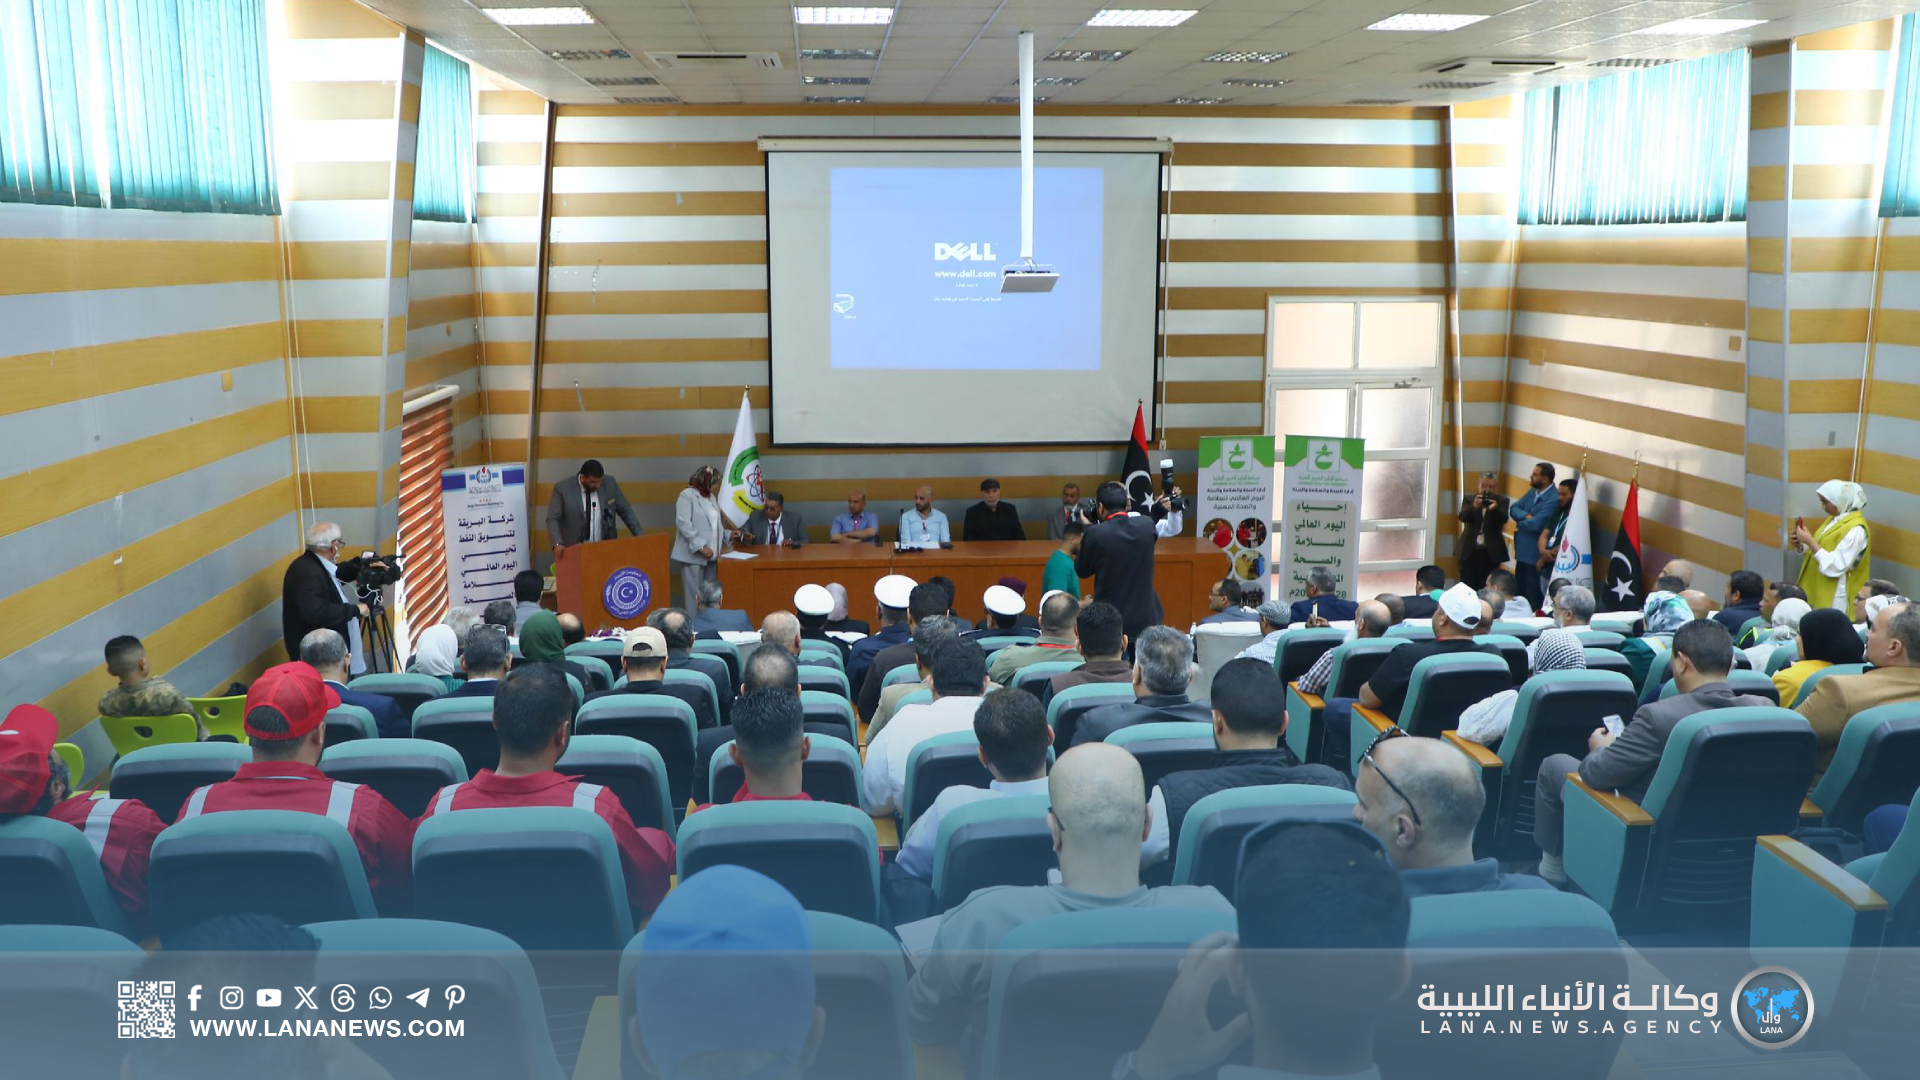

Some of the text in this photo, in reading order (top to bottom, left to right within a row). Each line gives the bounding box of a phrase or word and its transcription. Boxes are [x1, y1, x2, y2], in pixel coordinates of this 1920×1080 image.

[934, 242, 996, 262] DELL
[934, 269, 996, 279] www.dell.com
[1296, 501, 1347, 514] إحياء
[458, 513, 514, 529] شركة البريقة
[1294, 519, 1346, 532] اليوم العالمي
[459, 530, 515, 543] لتسويق النفط
[1295, 535, 1345, 547] للسلامة
[1293, 553, 1341, 567] والصحة
[461, 560, 518, 577] اليوم العالمي
